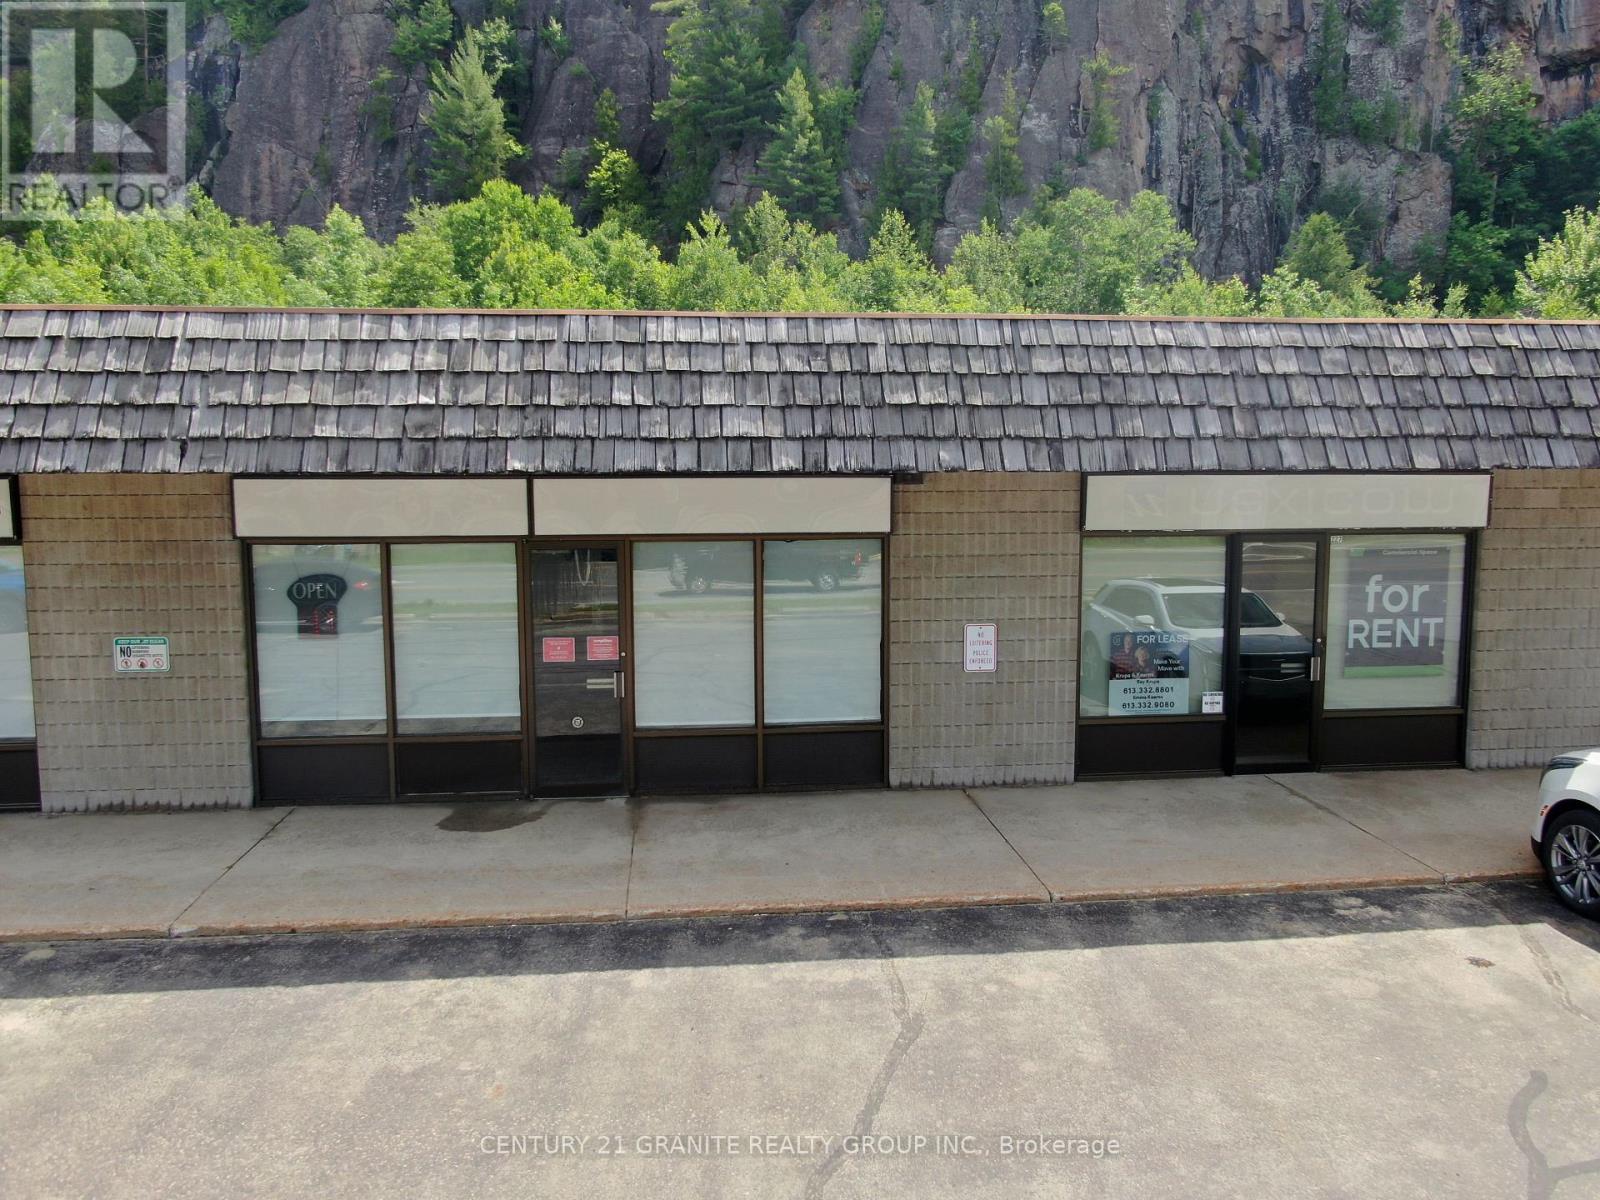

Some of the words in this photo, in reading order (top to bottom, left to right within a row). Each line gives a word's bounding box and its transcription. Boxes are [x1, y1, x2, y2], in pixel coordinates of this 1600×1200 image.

[293, 582, 337, 599] OPEN
[1365, 574, 1430, 613] for
[1136, 634, 1156, 644] FOR
[1158, 634, 1188, 644] LEASE
[1347, 617, 1444, 649] RENT
[120, 646, 132, 657] NO
